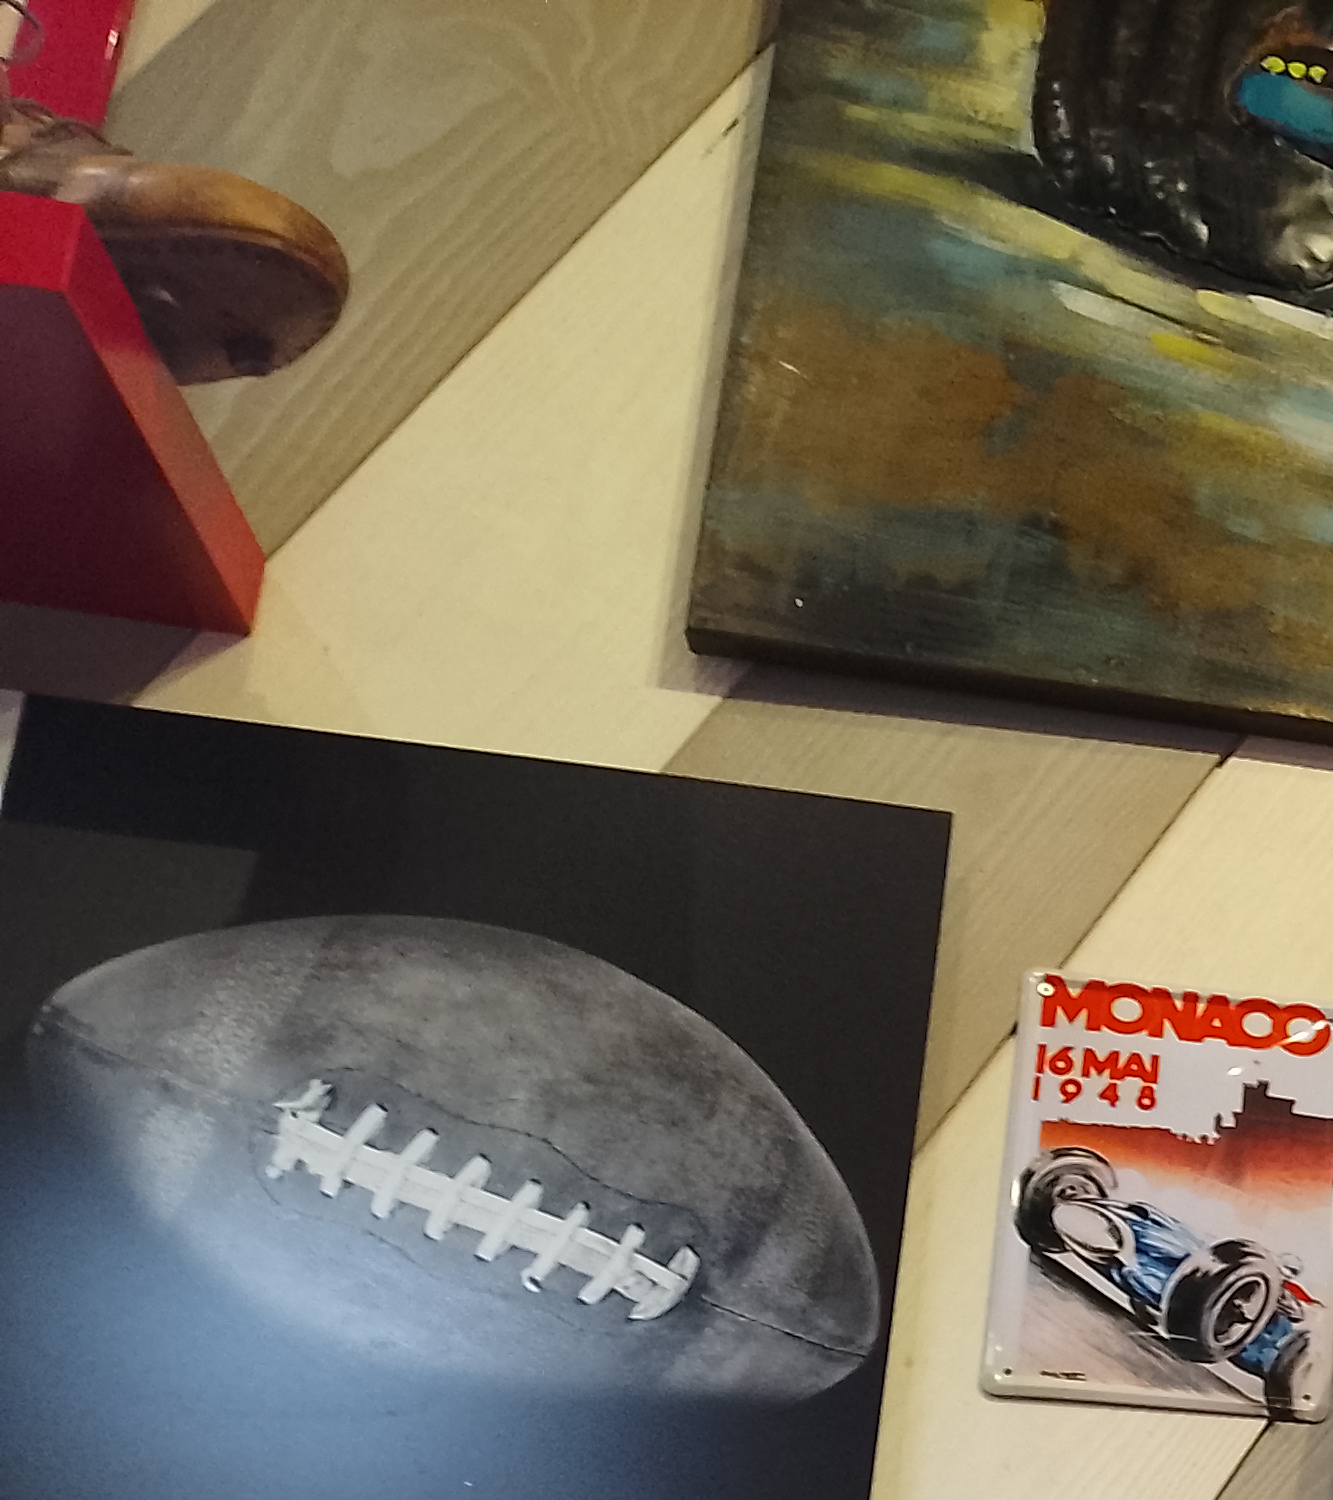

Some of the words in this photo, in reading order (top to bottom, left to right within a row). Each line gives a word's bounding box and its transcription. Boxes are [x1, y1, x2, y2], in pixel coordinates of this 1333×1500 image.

[1040, 973, 1331, 1056] MONACO
[1035, 1043, 1074, 1076] 16
[1081, 1047, 1160, 1084] MAI
[1031, 1074, 1157, 1111] 1948
